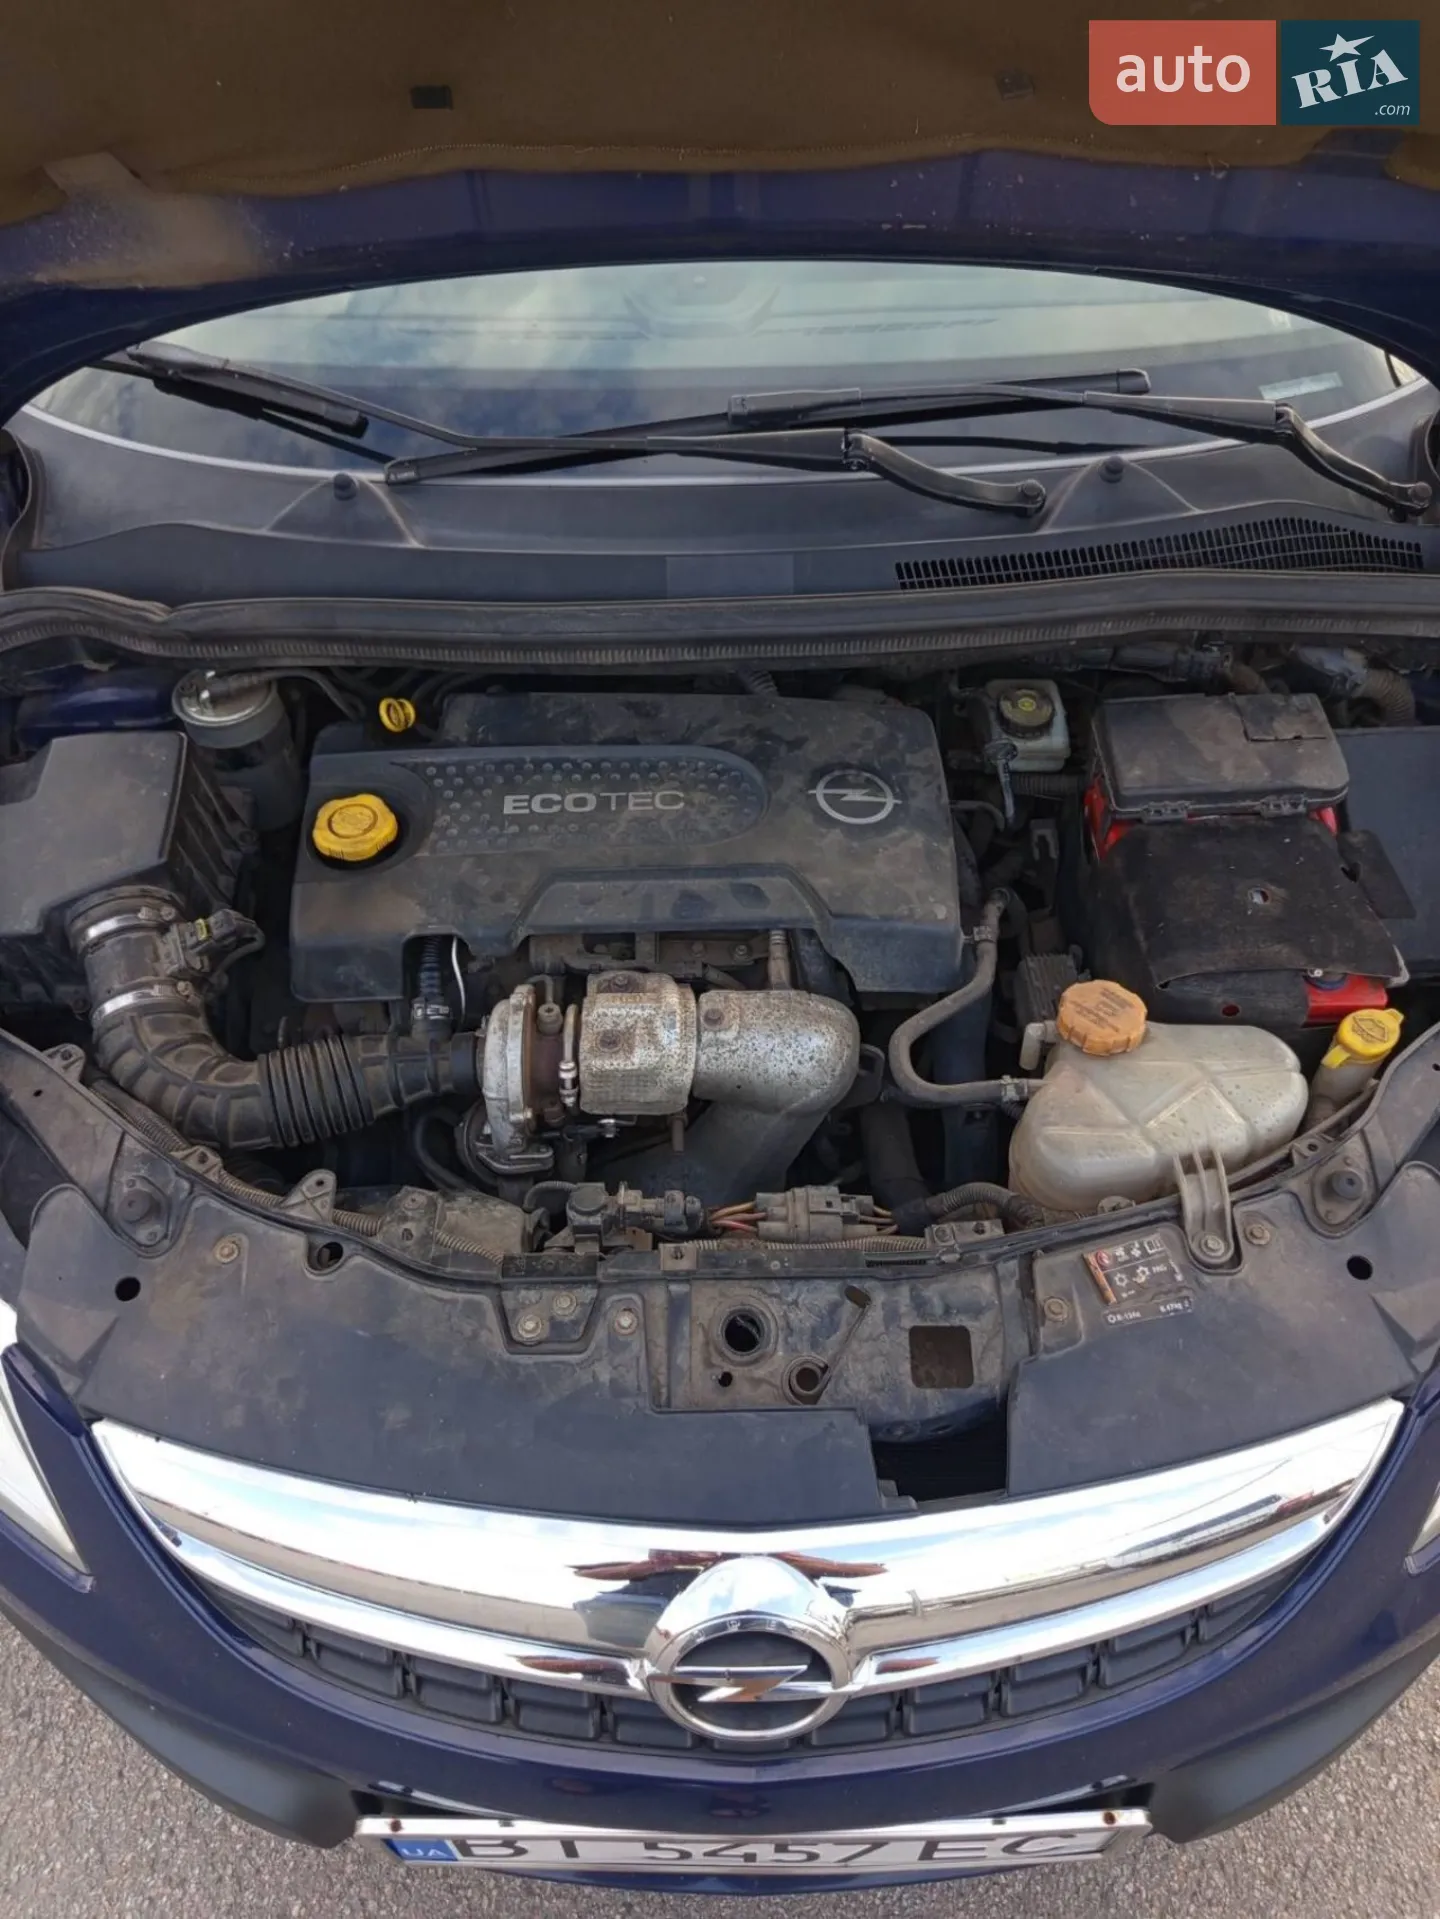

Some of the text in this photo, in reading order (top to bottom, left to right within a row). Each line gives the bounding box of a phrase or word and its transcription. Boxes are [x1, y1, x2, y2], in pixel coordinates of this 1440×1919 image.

[503, 790, 685, 814] ECOTEC
[401, 1846, 449, 1858] UA
[643, 1840, 890, 1863] 5457
